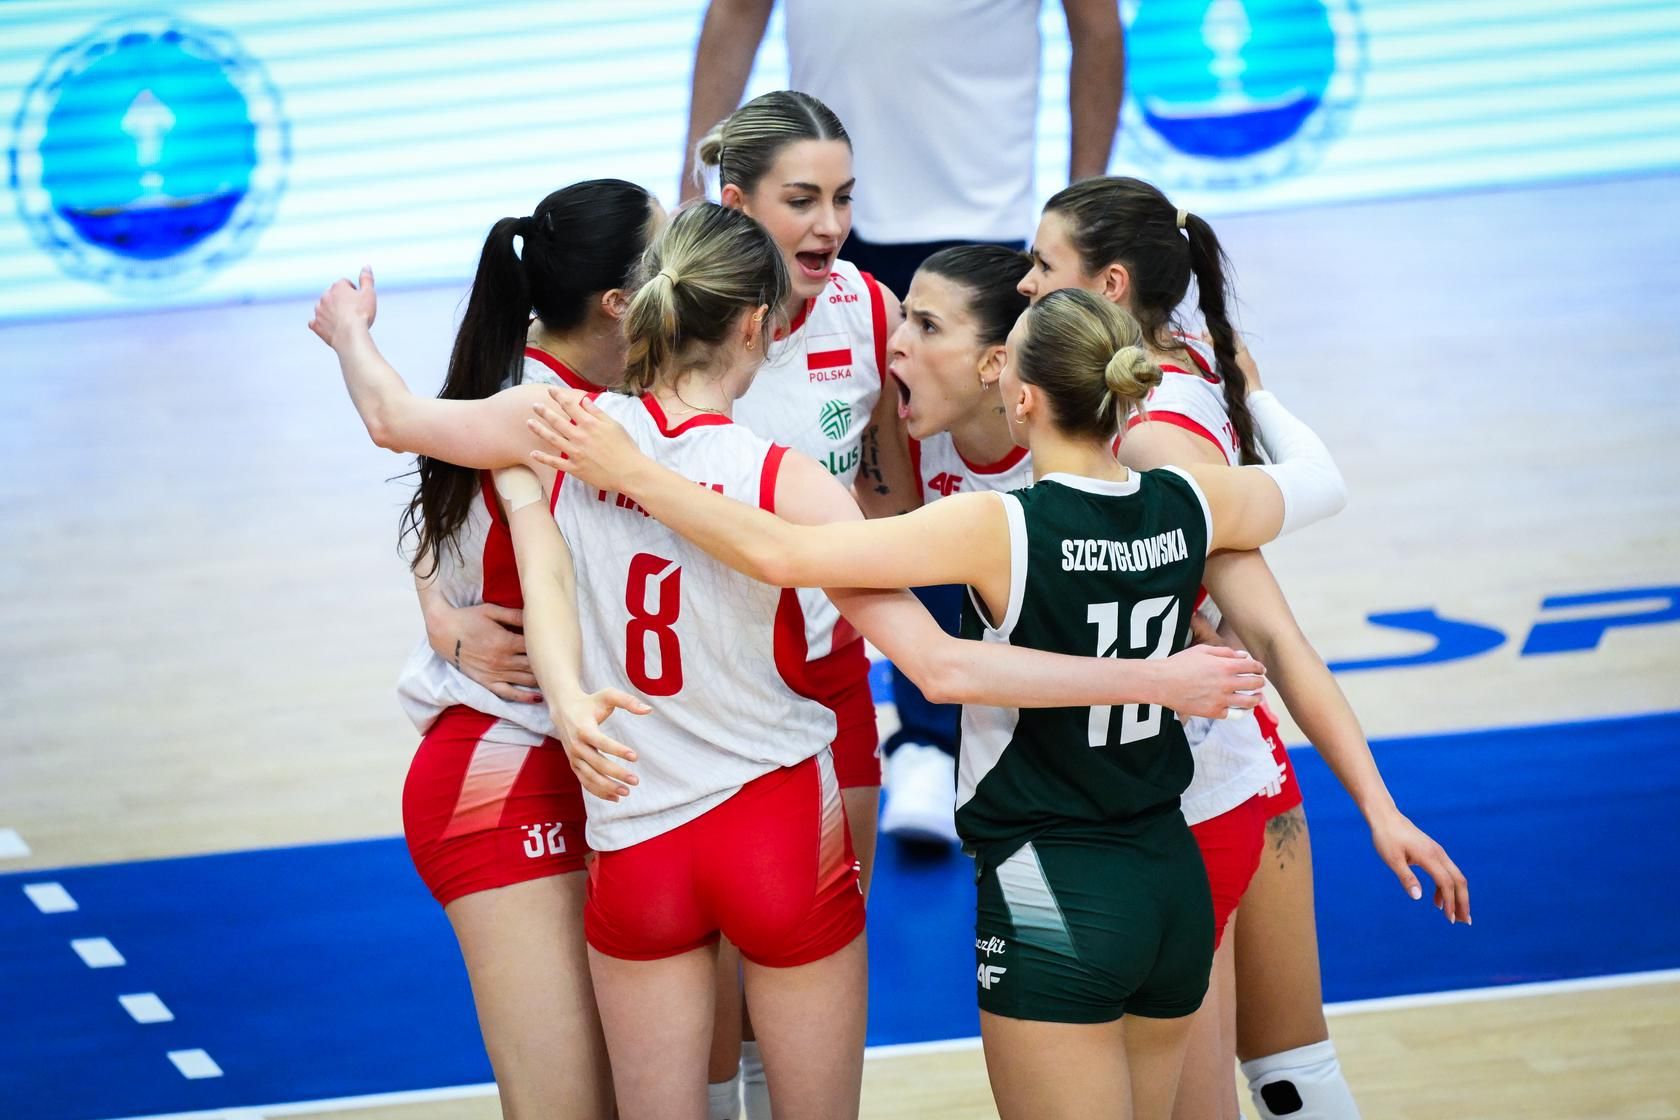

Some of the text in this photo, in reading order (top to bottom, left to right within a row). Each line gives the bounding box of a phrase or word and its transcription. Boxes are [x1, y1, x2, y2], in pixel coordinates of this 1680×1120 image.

[809, 369, 852, 383] POLSKA
[819, 445, 859, 476] lus
[928, 471, 963, 496] 4F
[1061, 528, 1189, 572] SZCZYGŁOWSKA
[625, 552, 683, 697] 8
[1087, 595, 1179, 747] 12
[521, 822, 567, 858] 32
